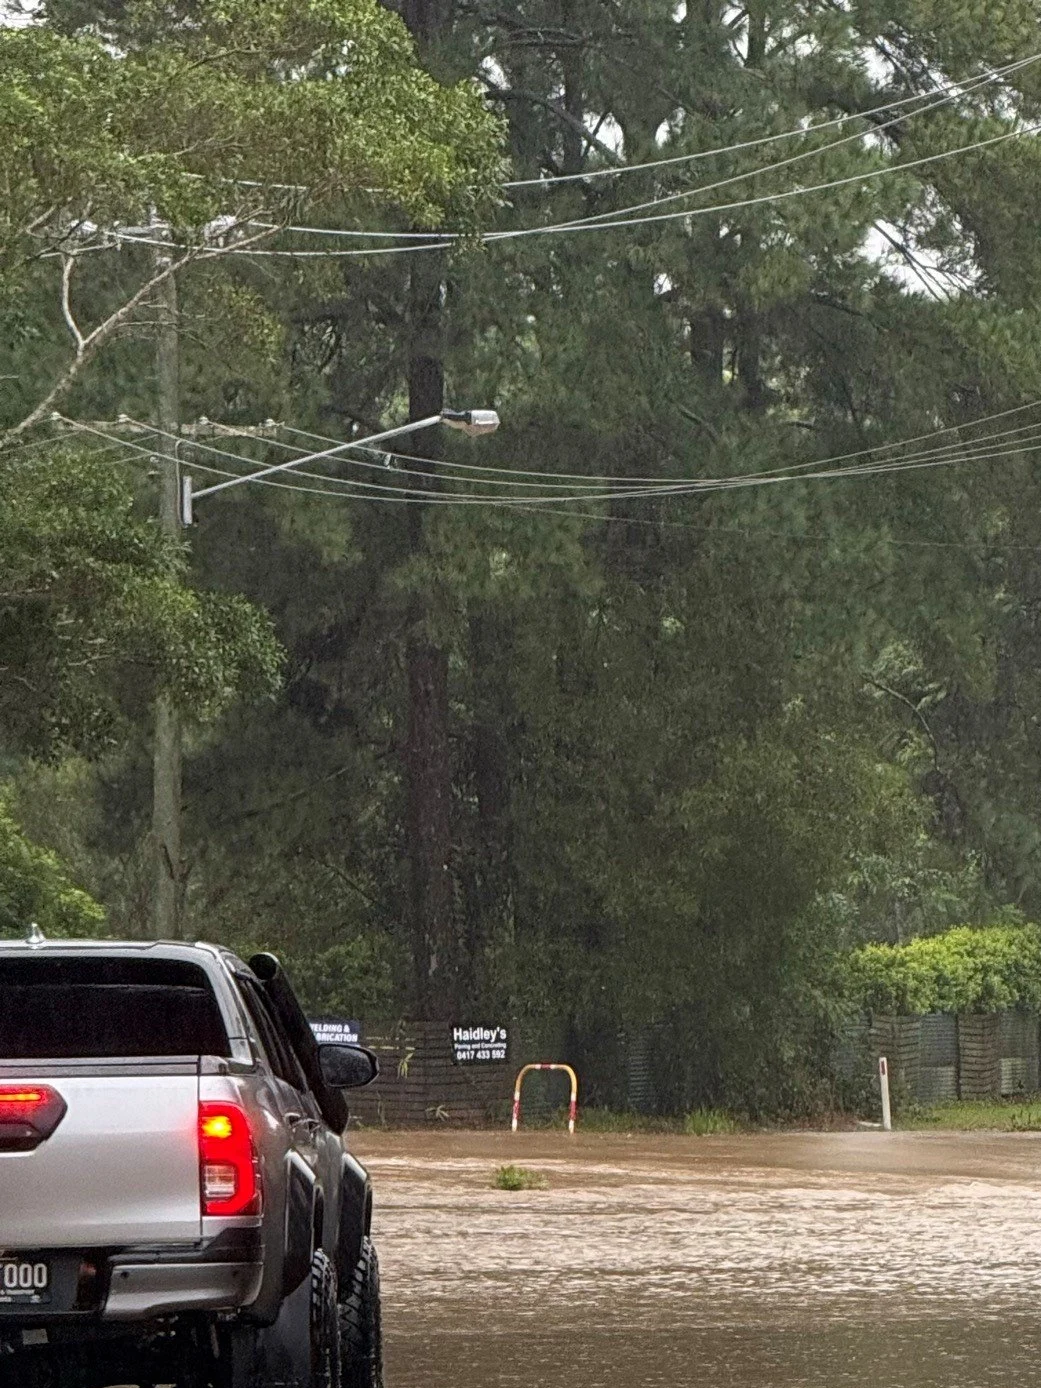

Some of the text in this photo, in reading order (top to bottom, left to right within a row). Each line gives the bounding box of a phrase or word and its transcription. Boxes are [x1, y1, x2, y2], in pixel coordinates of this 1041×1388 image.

[314, 1032, 358, 1042] BRICATION
[453, 1026, 507, 1043] Haidley's
[456, 1050, 475, 1060] 0417
[0, 1263, 48, 1288] 000
